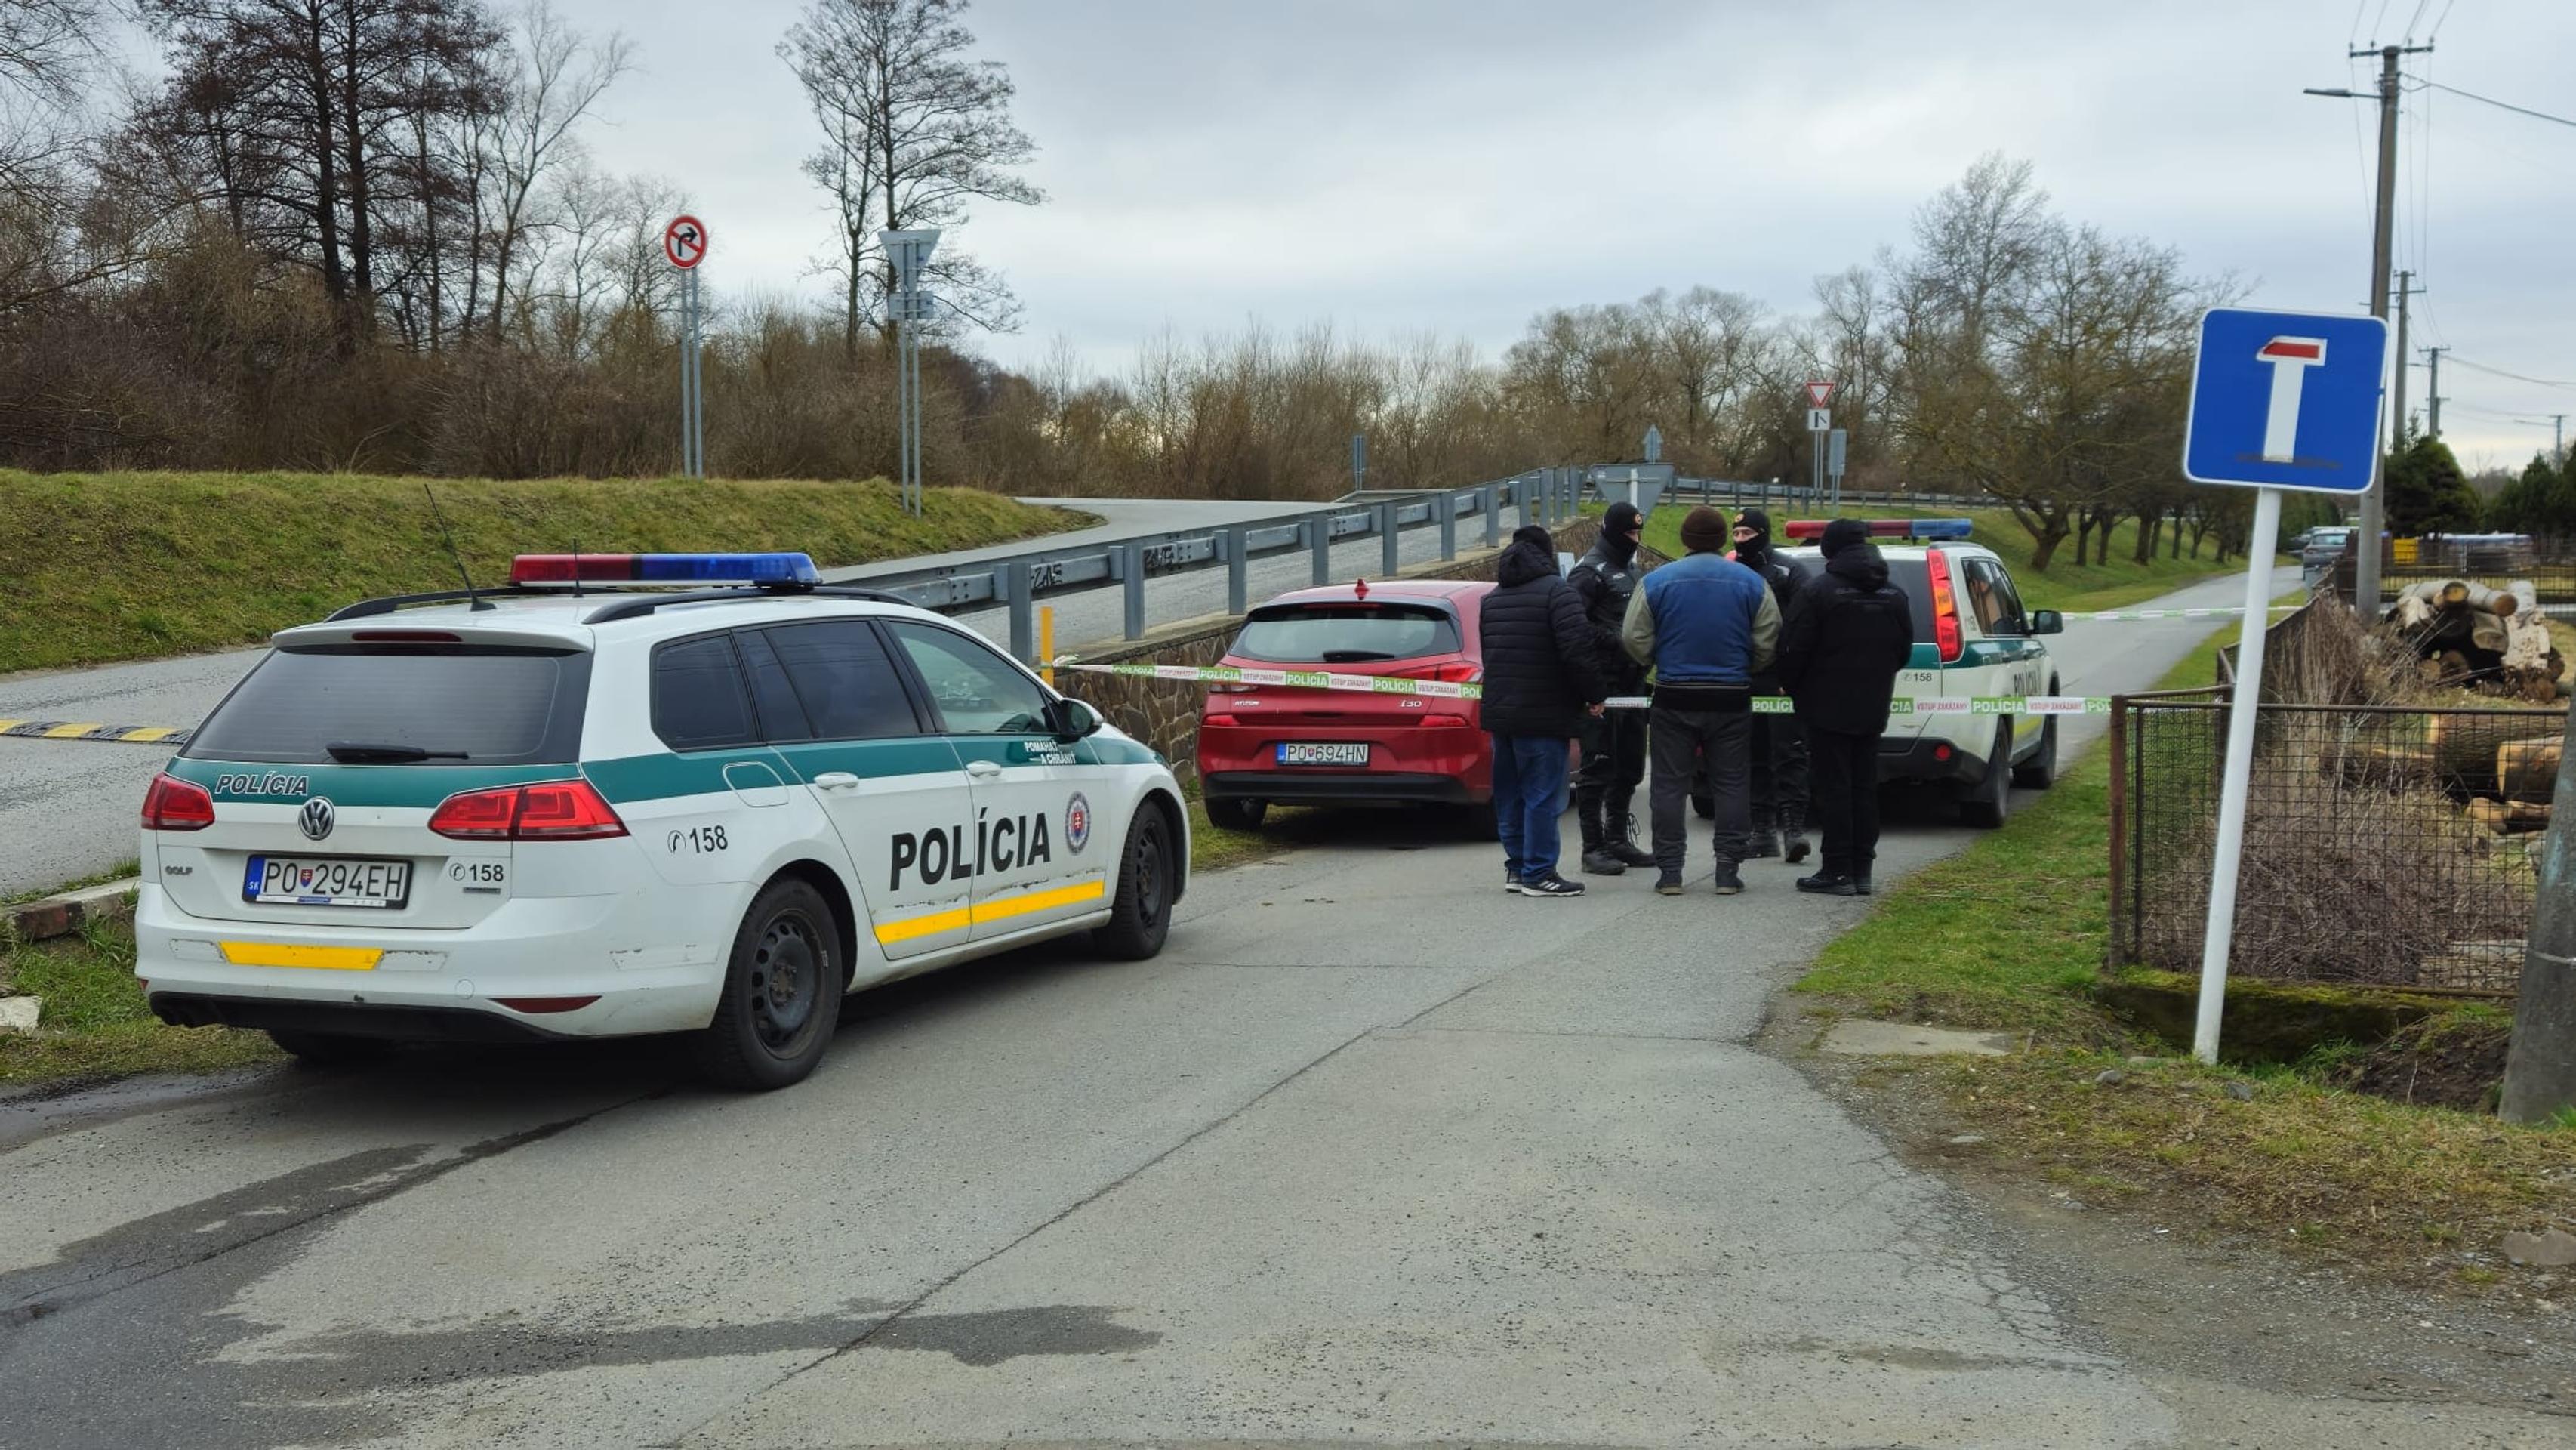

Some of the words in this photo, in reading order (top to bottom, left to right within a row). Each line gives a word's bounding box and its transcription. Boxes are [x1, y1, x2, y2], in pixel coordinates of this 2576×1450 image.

[1200, 667, 1240, 680] POLÍCIA
[1286, 673, 1327, 686] POLÍCIA
[1375, 678, 1415, 693] POLÍCIA
[1914, 672, 1933, 682] 158
[1752, 698, 1794, 713] POLÍCI
[1973, 699, 2025, 713] POLÍCIA
[214, 770, 309, 797] POLÍCIA
[689, 825, 728, 853] 158
[889, 807, 1051, 892] POLÍCIA
[469, 864, 504, 882] 158
[248, 881, 259, 890] SK
